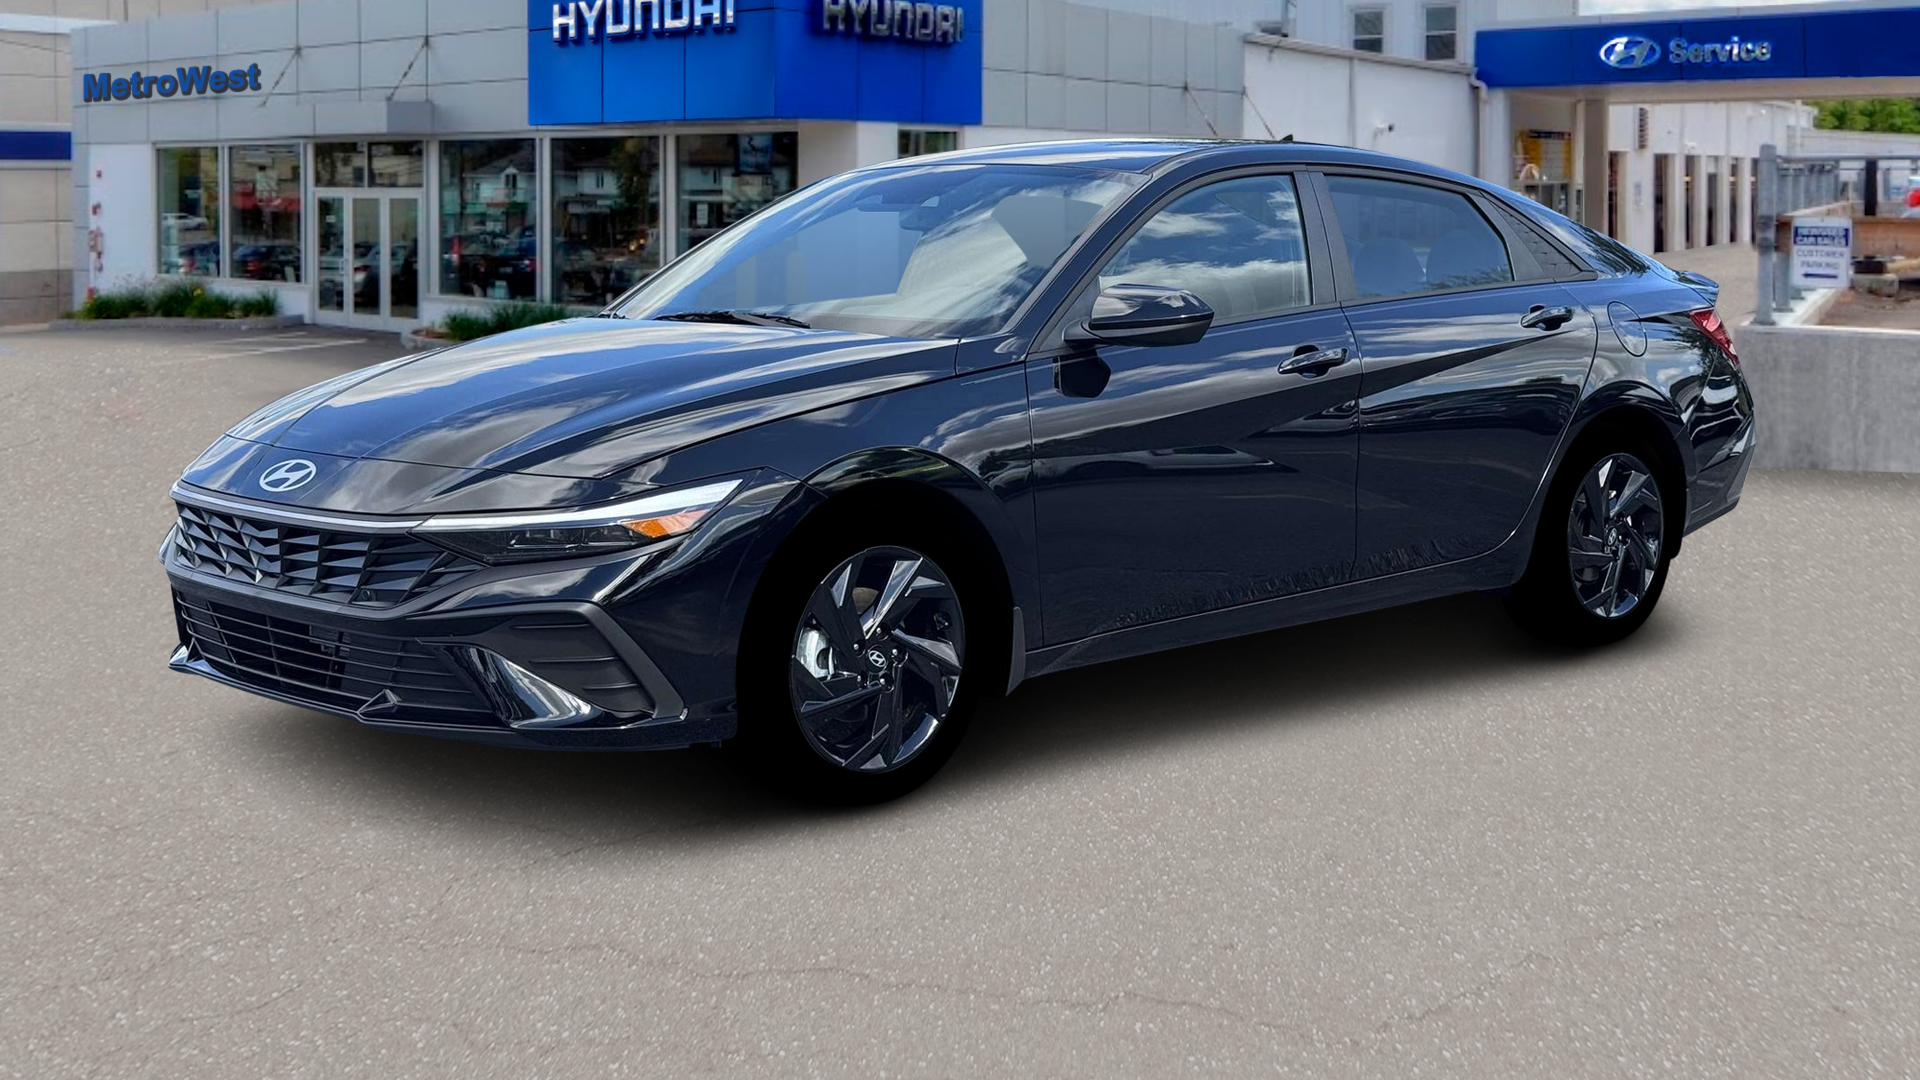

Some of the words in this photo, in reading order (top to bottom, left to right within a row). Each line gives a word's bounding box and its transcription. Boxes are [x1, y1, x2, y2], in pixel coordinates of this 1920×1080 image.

[552, 0, 735, 42] HYUNDAI
[822, 0, 965, 44] HYUNDAI
[1668, 35, 1772, 64] Service
[83, 62, 262, 103] MetroWest
[1796, 248, 1845, 258] CUSTOMER
[1800, 260, 1841, 270] PARKING
